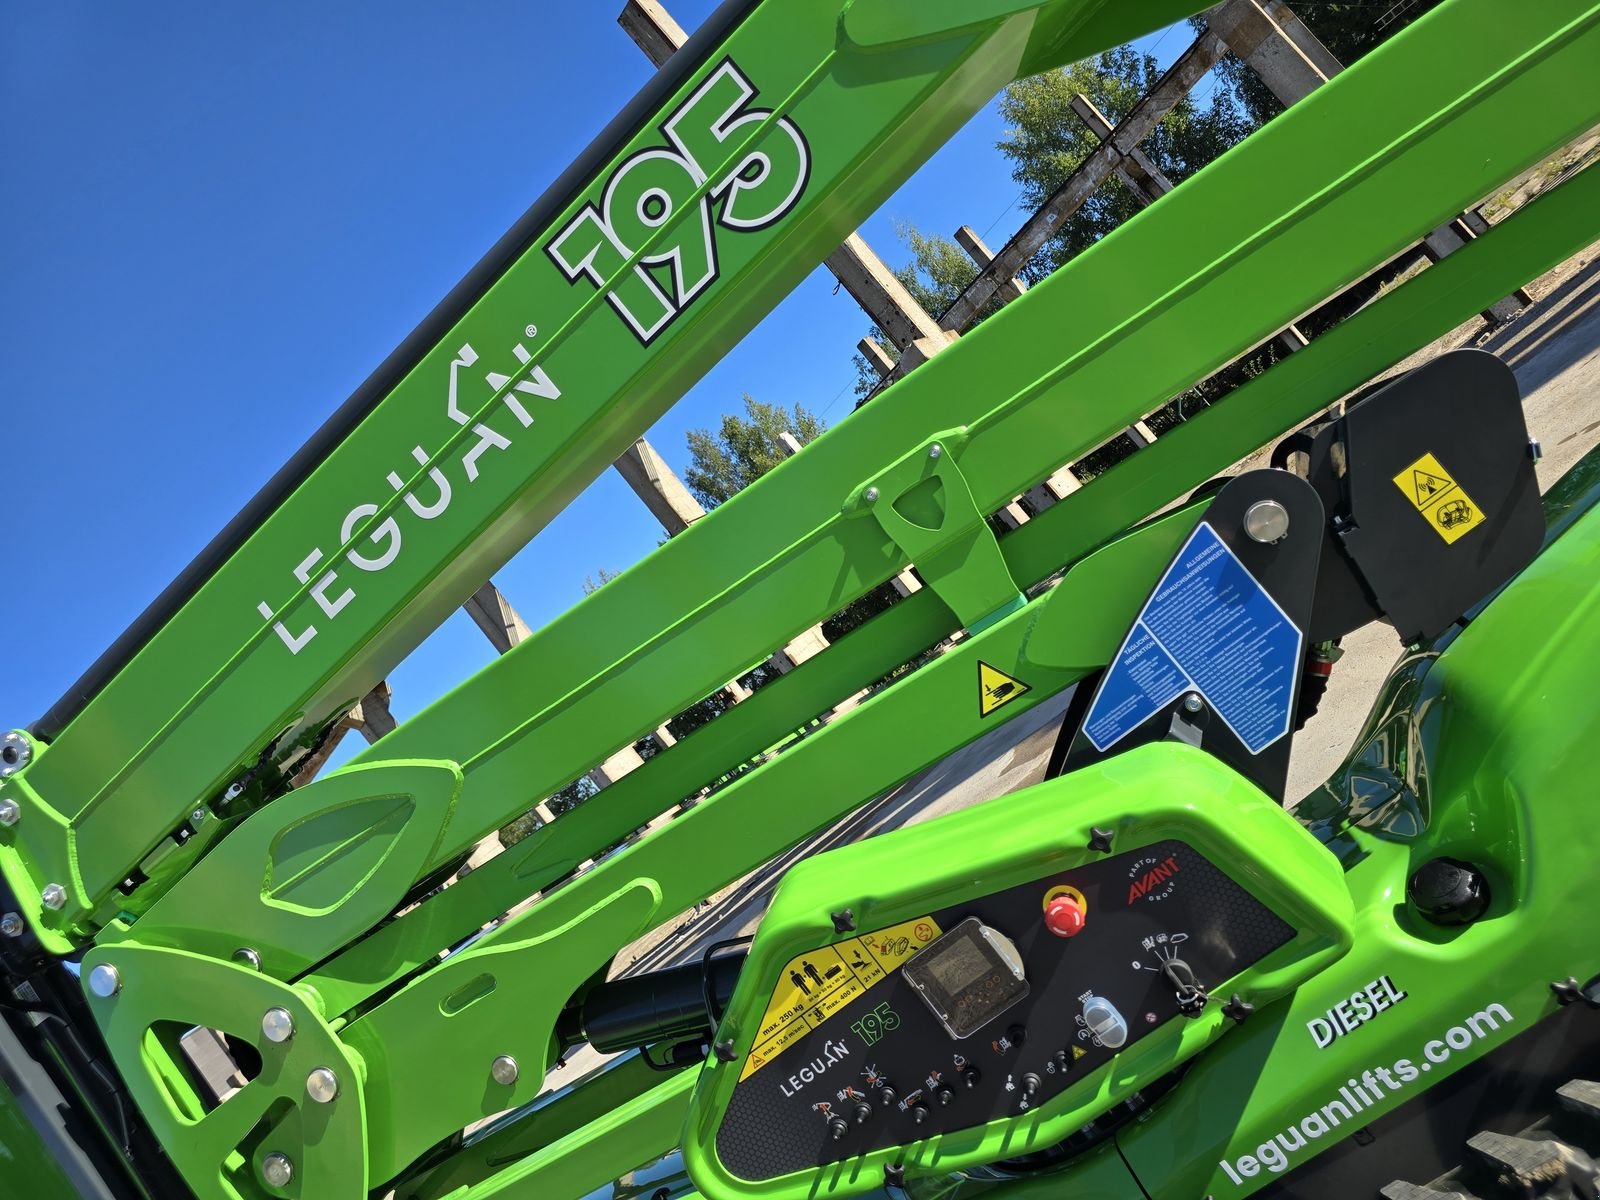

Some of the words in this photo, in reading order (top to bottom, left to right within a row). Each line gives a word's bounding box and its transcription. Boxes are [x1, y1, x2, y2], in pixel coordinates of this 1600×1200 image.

[542, 54, 812, 348] 195
[1185, 541, 1220, 569] ALLGEMEINE
[1155, 548, 1225, 602] GEBRAUCHSANWEISUNGEN
[1124, 640, 1156, 666] INSPEKTION
[1127, 855, 1180, 905] AVANT
[1128, 859, 1144, 878] PART
[1148, 881, 1175, 901] GROUP
[863, 975, 871, 983] 21
[871, 968, 880, 977] kN
[825, 1000, 840, 1011] max.
[840, 990, 851, 1000] 400
[1077, 989, 1093, 1001] START
[762, 1023, 780, 1036] max.
[779, 1010, 794, 1023] 250
[794, 1003, 805, 1014] kg
[850, 1001, 900, 1047] 195
[1305, 974, 1409, 1050] DIESEL
[762, 1045, 777, 1057] max.
[1218, 1001, 1514, 1187] leguanlifts.com
